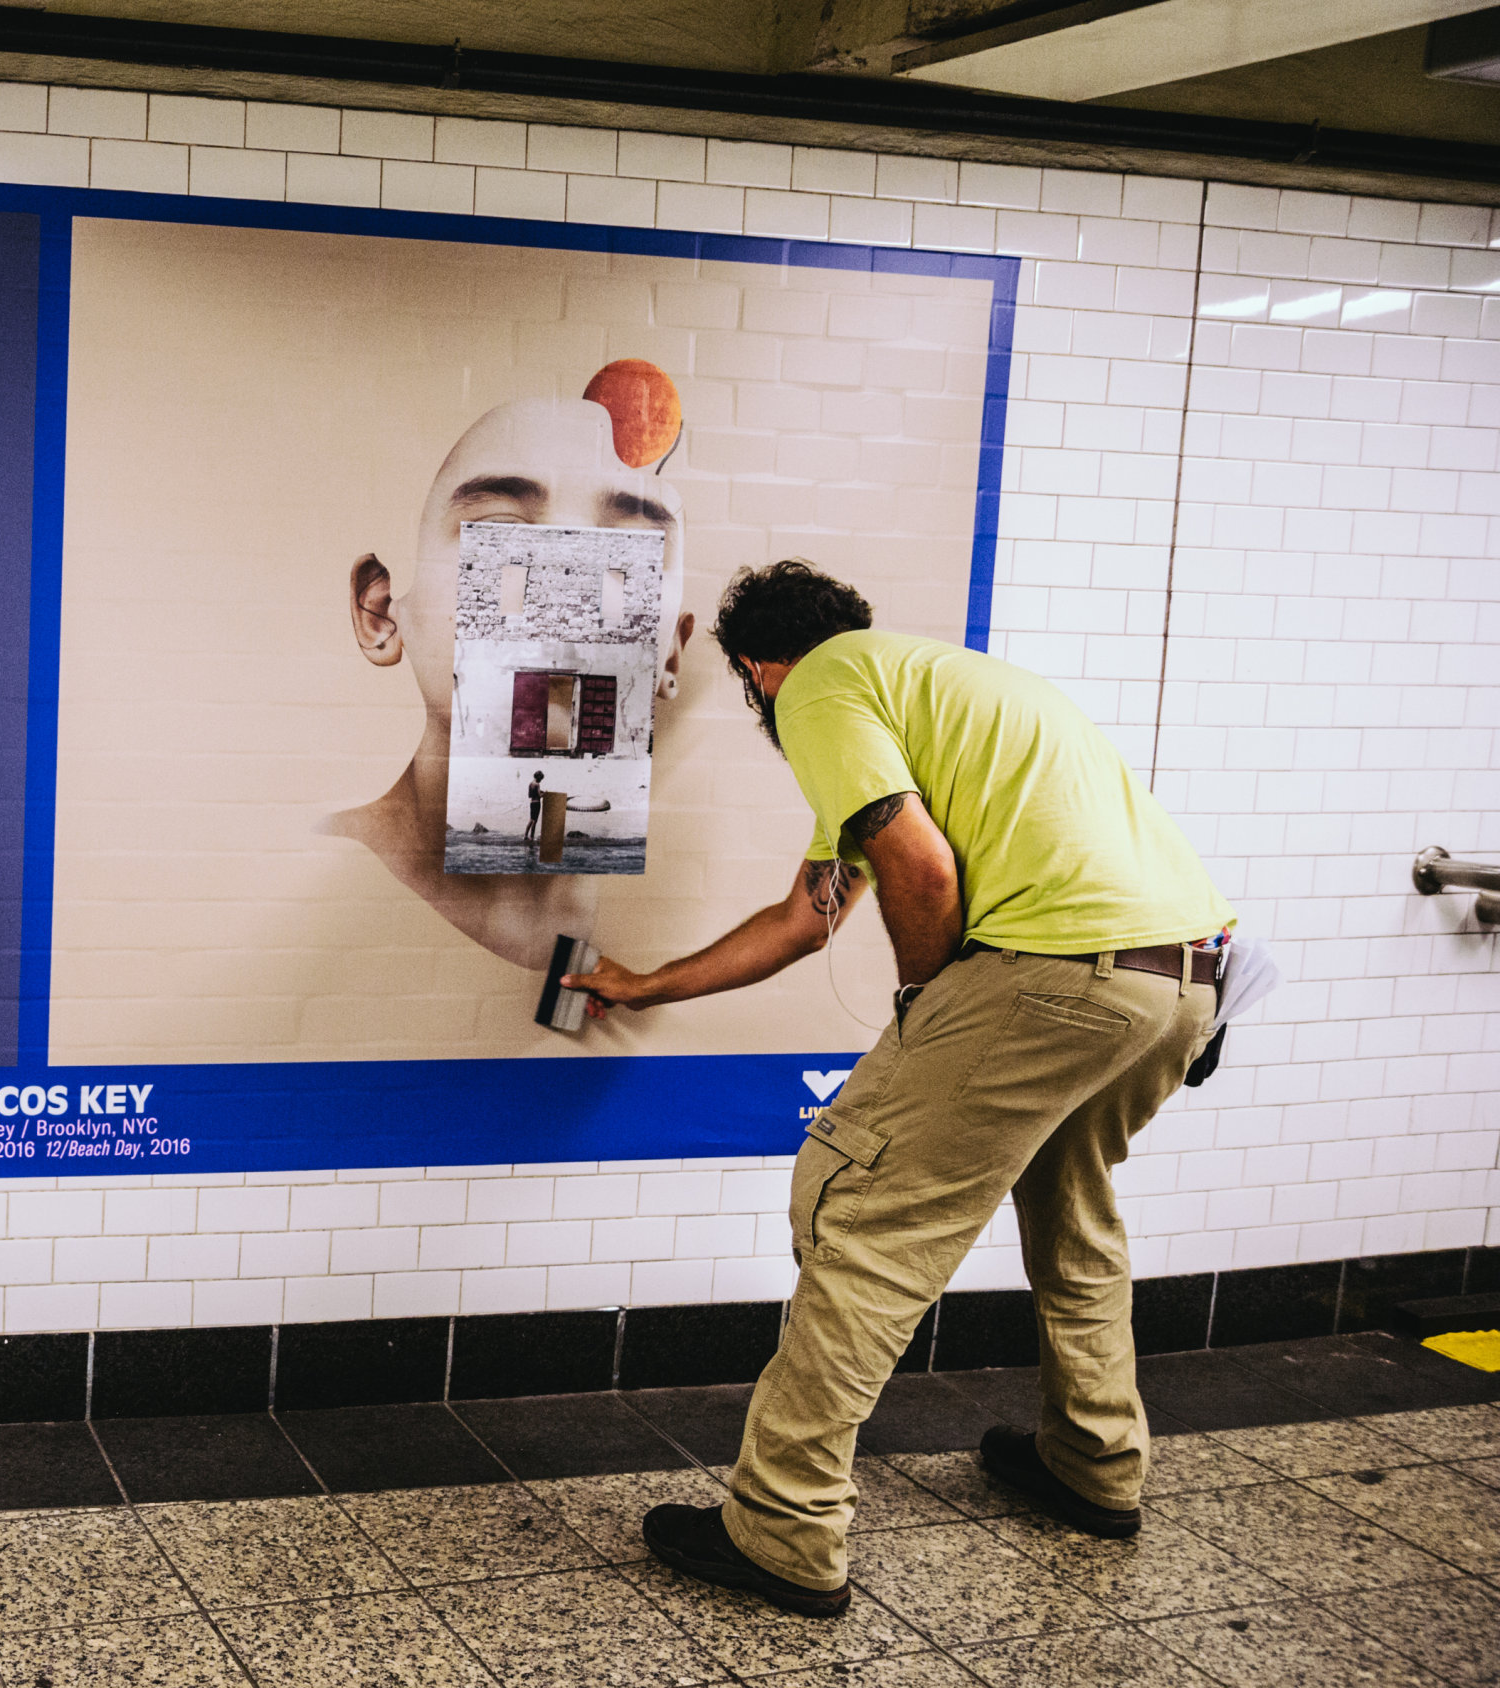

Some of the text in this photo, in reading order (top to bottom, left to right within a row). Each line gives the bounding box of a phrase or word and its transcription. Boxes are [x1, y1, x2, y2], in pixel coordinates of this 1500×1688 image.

[79, 1084, 154, 1116] KEY
[798, 1106, 831, 1119] LIV
[21, 1119, 30, 1139] /
[36, 1118, 117, 1139] Brooklyn,
[122, 1117, 158, 1135] NYC
[46, 1139, 111, 1158] 12/Beach
[114, 1139, 145, 1160] Day,
[150, 1137, 191, 1156] 2016
